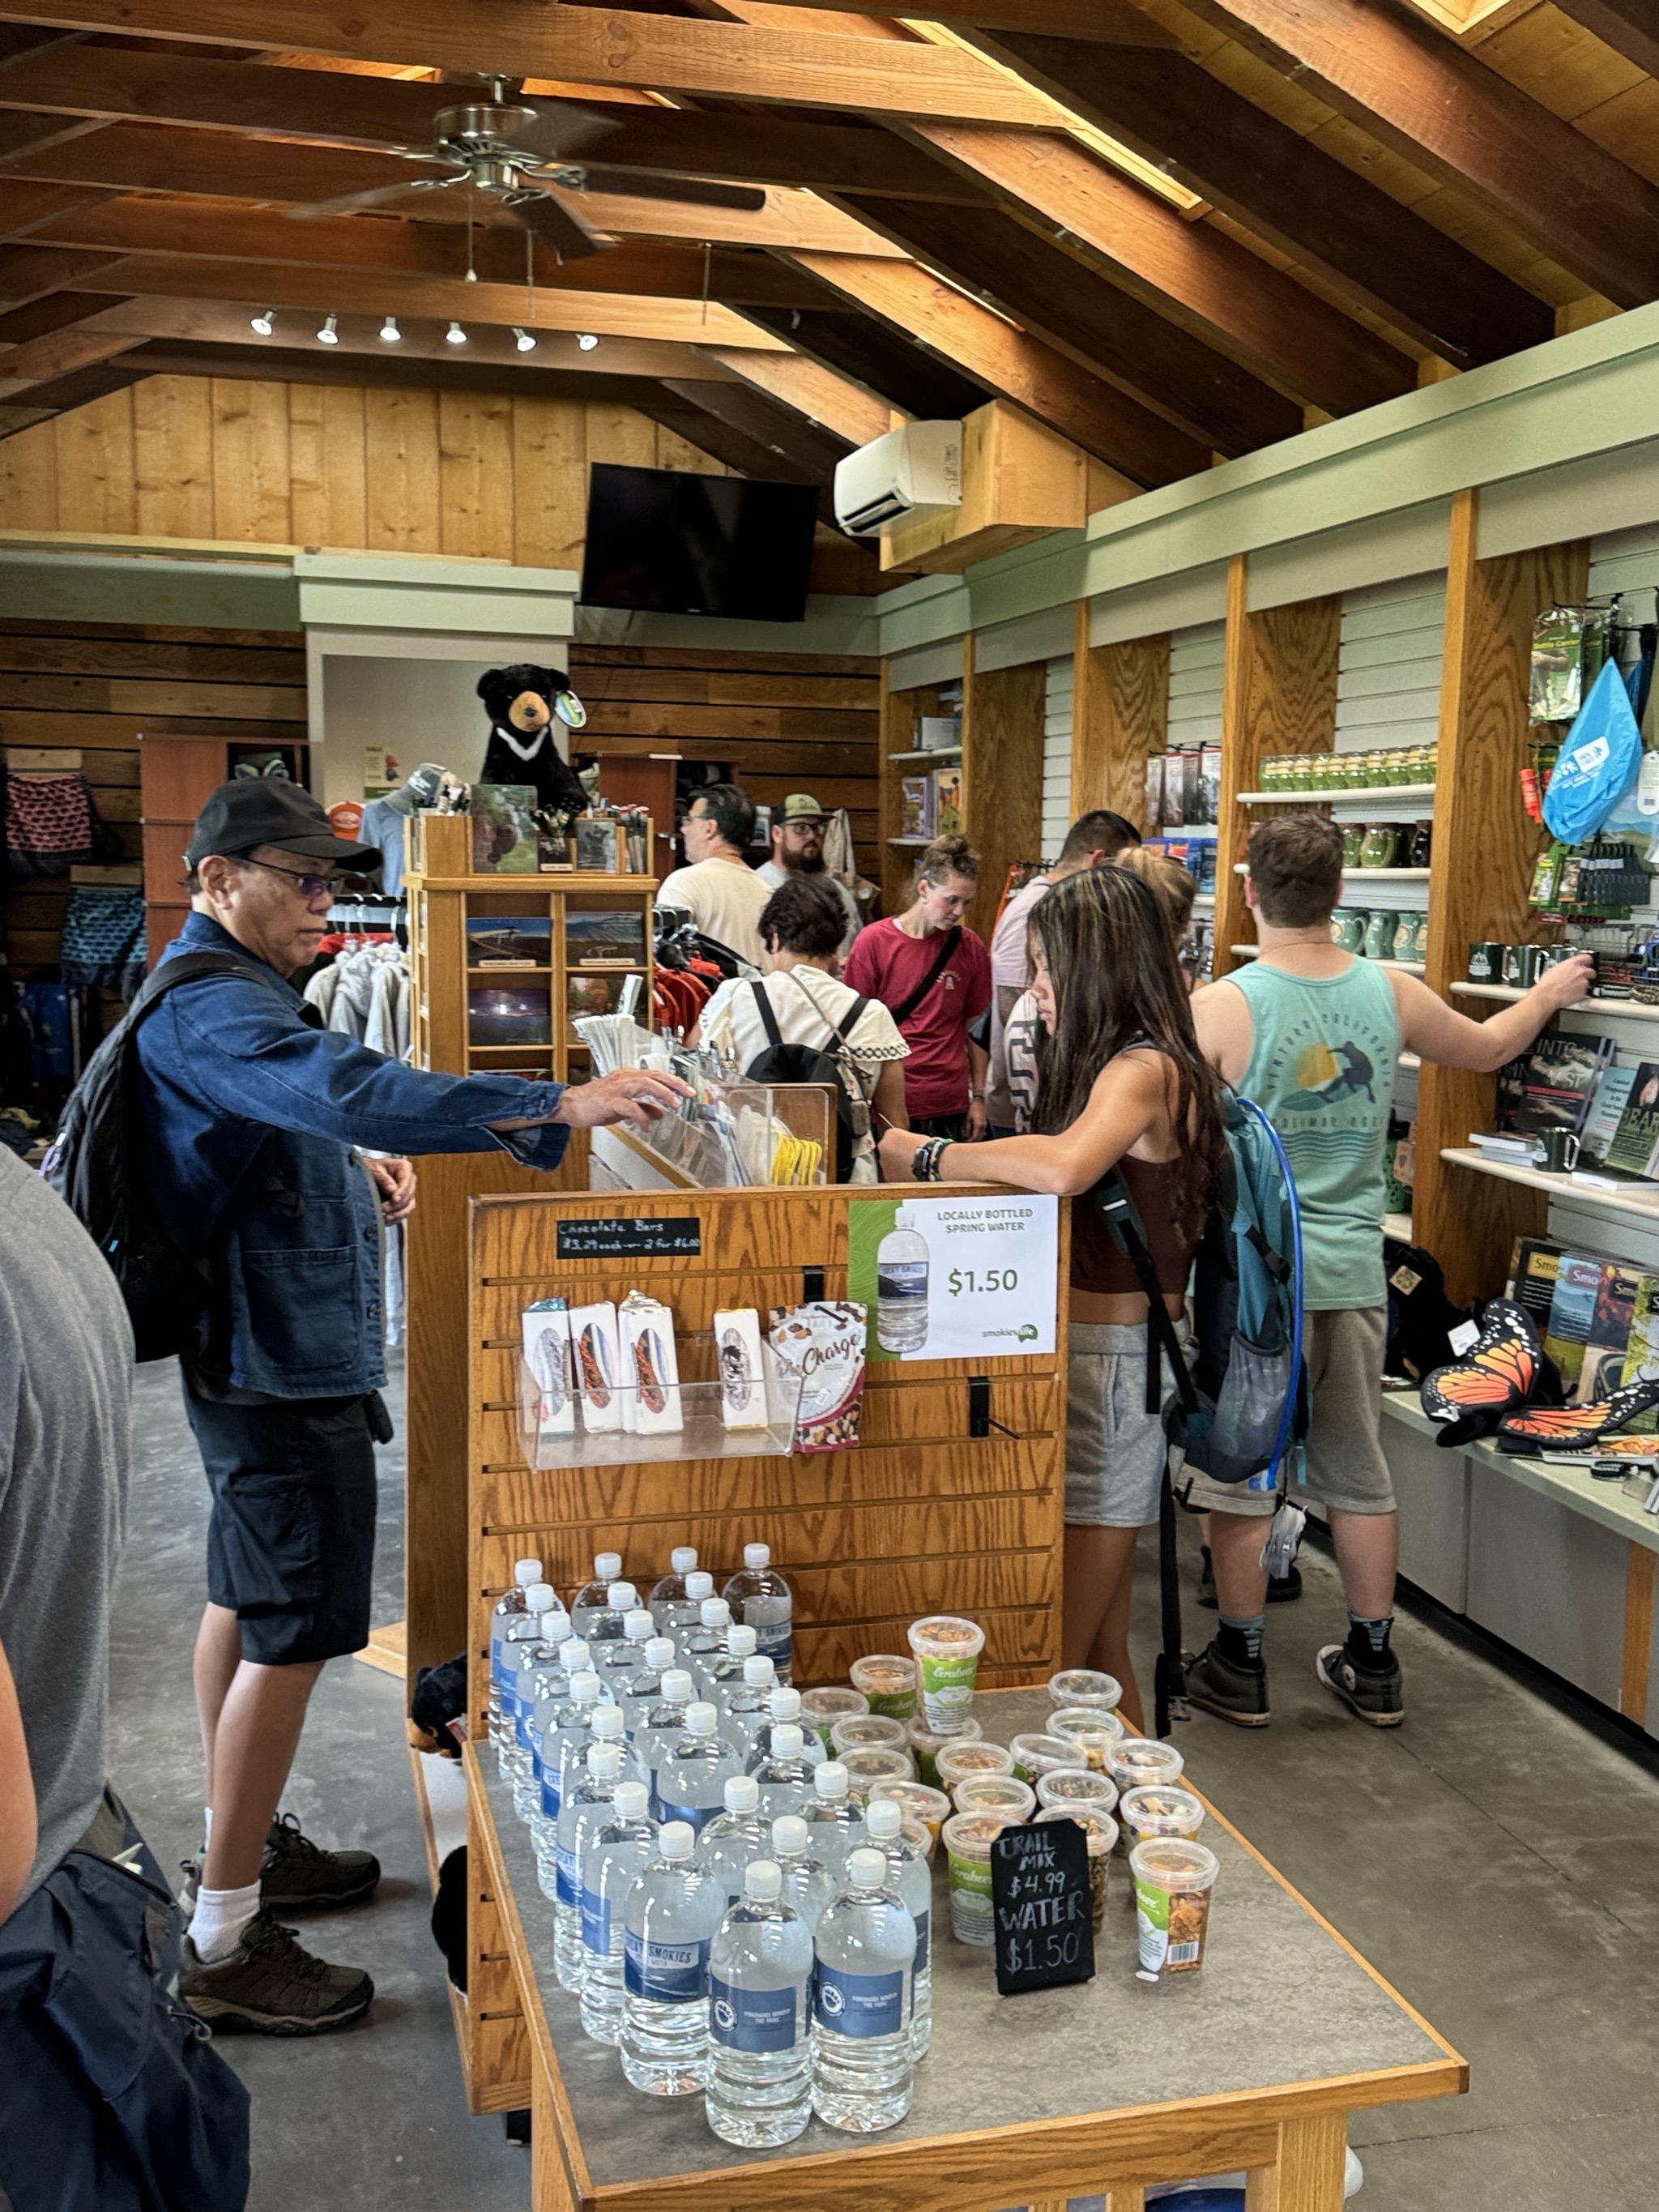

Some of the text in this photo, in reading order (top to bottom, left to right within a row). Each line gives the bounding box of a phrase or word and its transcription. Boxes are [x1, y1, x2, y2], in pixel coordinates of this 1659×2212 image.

[633, 1219, 664, 1232] Bars
[937, 1208, 1034, 1221] LOCALLY BOTTLED
[945, 1222, 1026, 1234] SPRING WATER
[948, 1267, 1018, 1297] $1.50
[996, 1830, 1056, 1860] TRAIL
[1018, 1851, 1057, 1872] MIX
[1008, 1871, 1065, 1898] $4.99
[999, 1890, 1085, 1932] WATER
[648, 1945, 692, 1964] SMOKIES
[1004, 1932, 1079, 1975] $1.50
